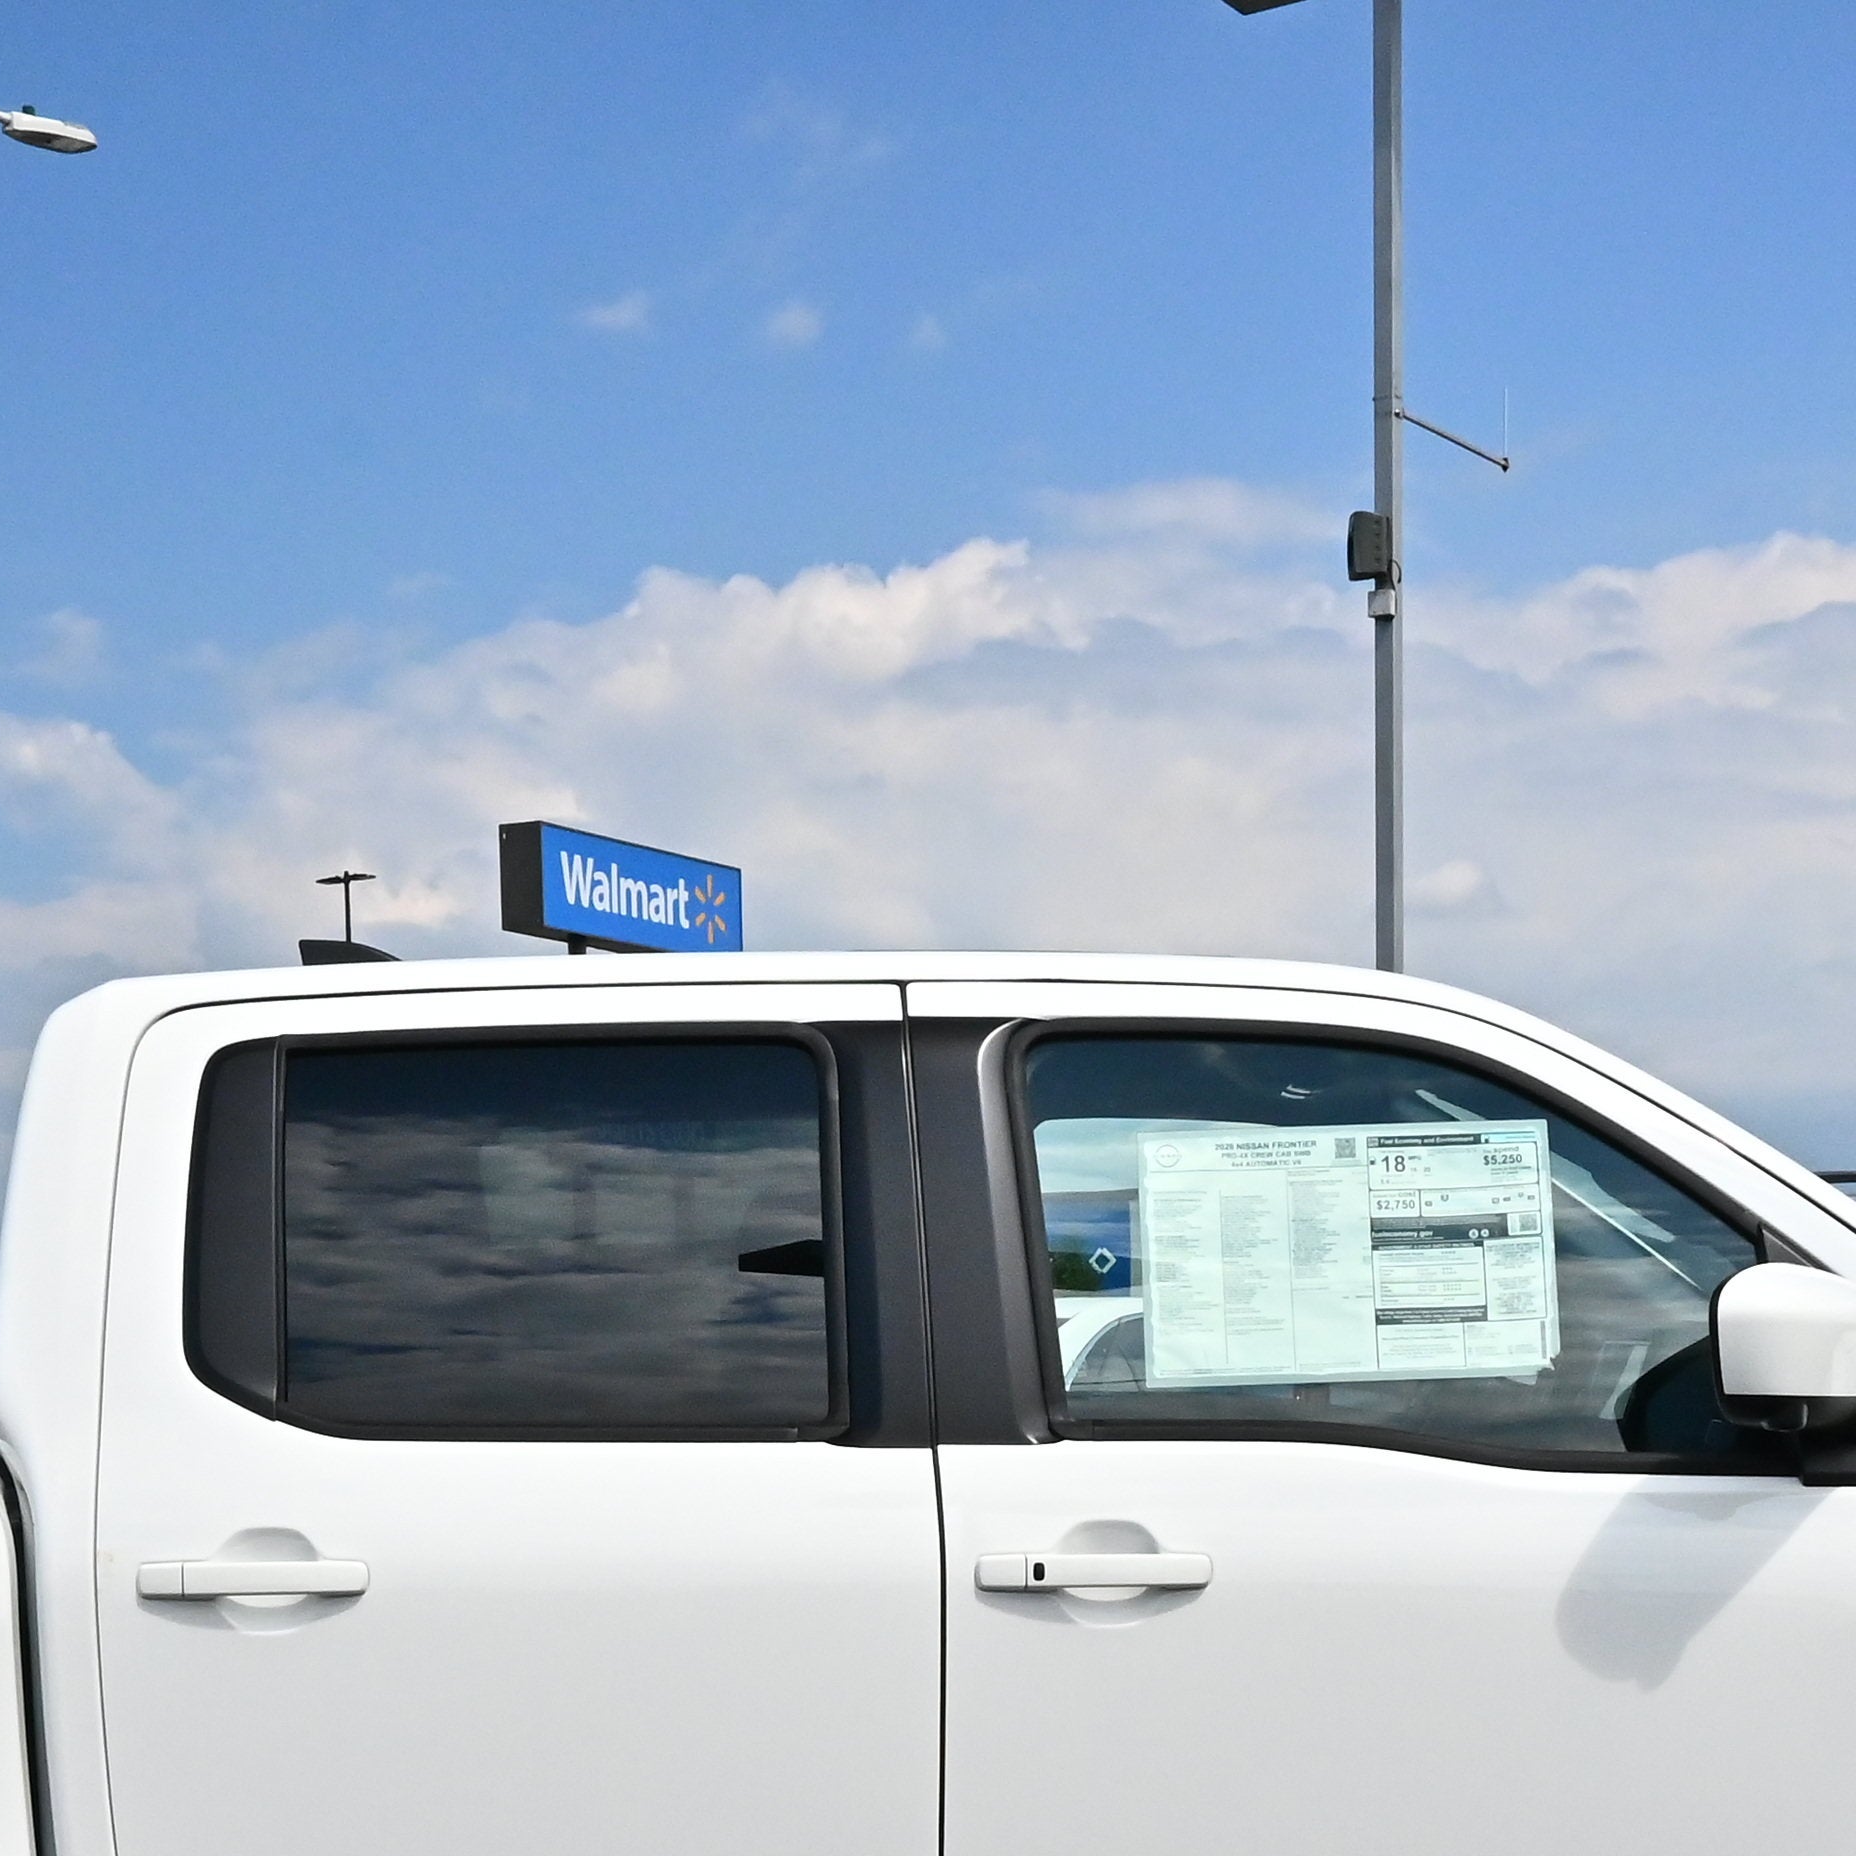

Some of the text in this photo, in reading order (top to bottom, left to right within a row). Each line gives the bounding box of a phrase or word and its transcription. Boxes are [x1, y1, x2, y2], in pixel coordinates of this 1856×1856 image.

[560, 851, 690, 929] Walmart
[1236, 1142, 1269, 1150] NISSAN
[1272, 1140, 1317, 1149] FRONTIER
[1381, 1155, 1406, 1173] 18
[1376, 1200, 1416, 1211] $2,750
